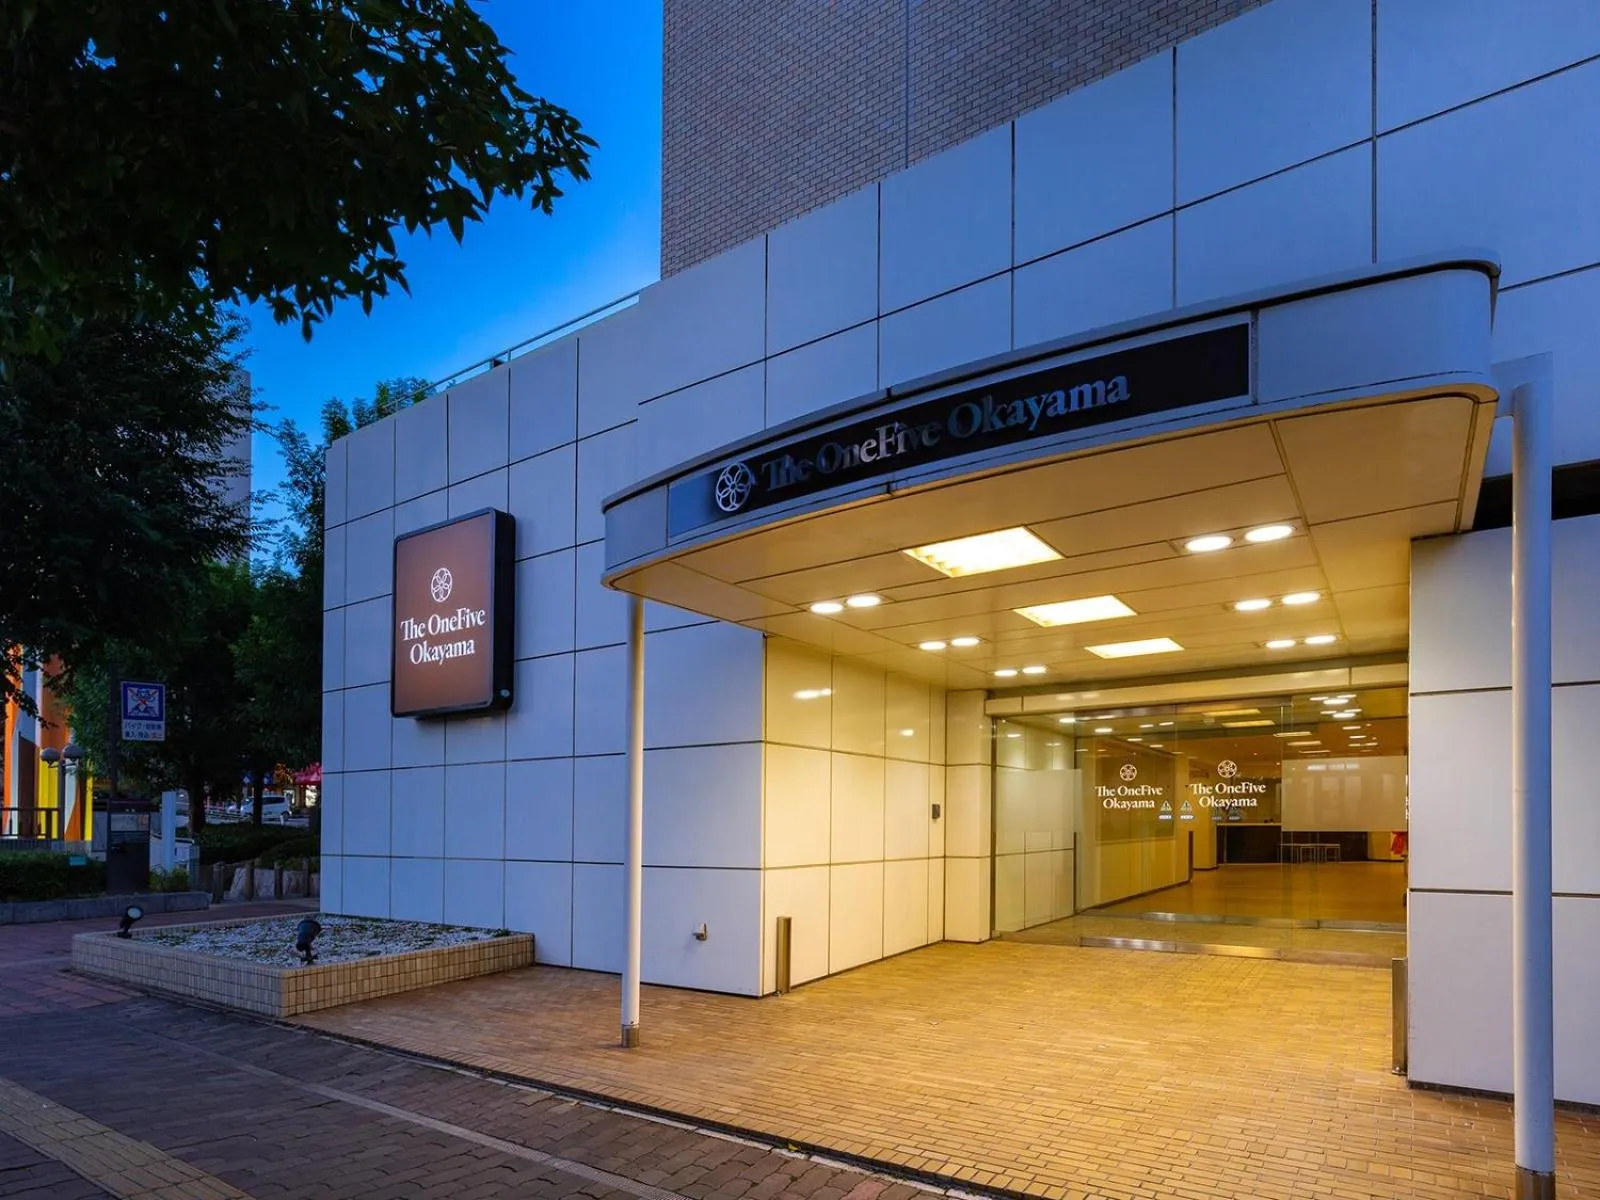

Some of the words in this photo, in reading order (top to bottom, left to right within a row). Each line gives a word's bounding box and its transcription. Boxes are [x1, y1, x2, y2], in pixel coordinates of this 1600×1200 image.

[760, 453, 814, 492] The
[816, 420, 940, 475] OneFive
[947, 373, 1131, 439] Okayama
[400, 617, 426, 641] The
[428, 607, 486, 636] OneFive
[410, 640, 475, 666] Okayama
[1094, 785, 1116, 797] The
[1117, 784, 1164, 797] OneFive
[1190, 782, 1213, 795] The
[1214, 781, 1267, 795] OneFive
[1103, 797, 1155, 811] Okayama
[1198, 795, 1258, 810] Okayama
